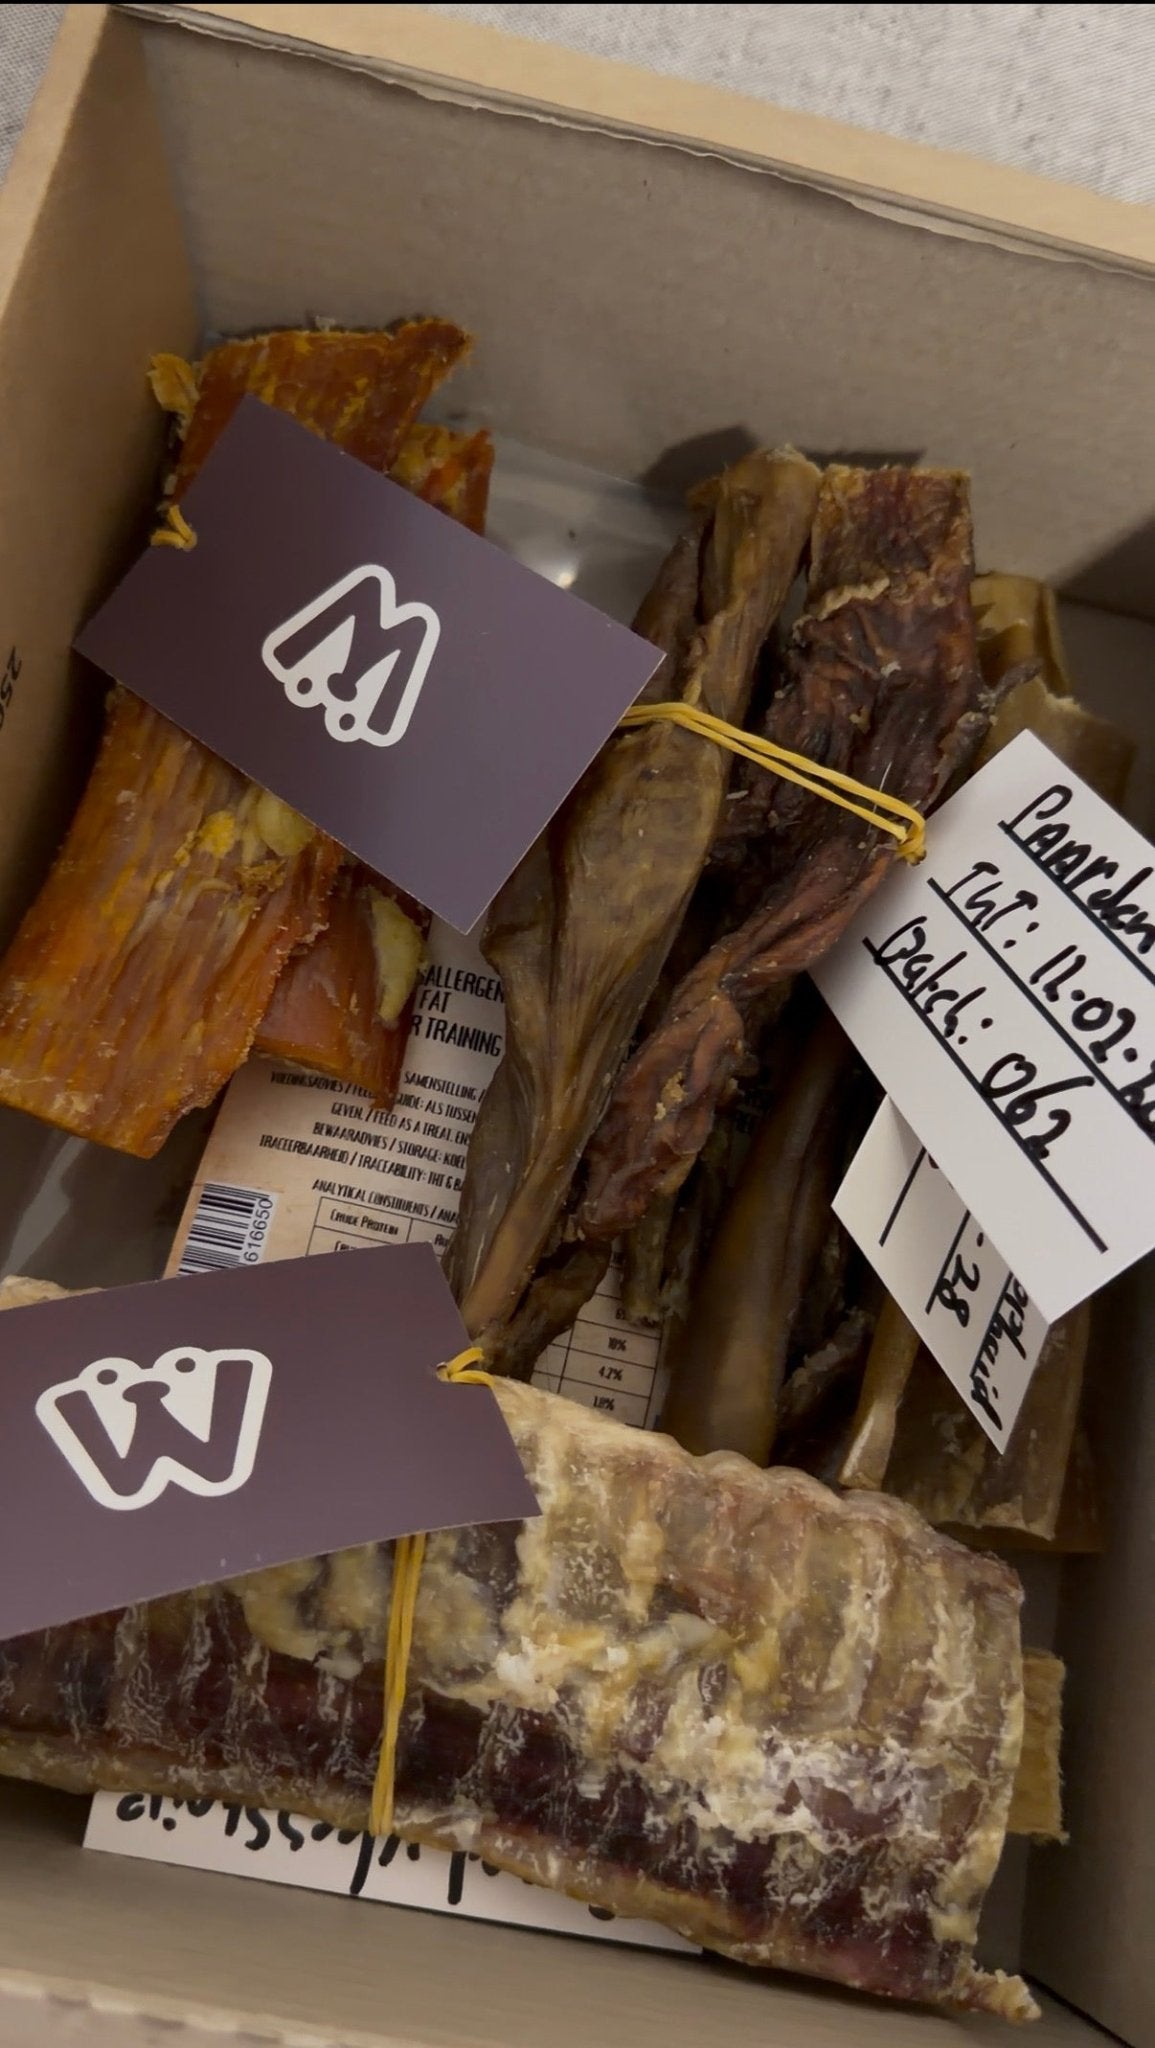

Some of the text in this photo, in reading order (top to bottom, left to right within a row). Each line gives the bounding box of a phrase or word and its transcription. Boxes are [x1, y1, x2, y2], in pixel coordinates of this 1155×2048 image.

[419, 990, 452, 1013] FAT
[425, 1016, 503, 1057] TRAINING
[404, 1070, 477, 1102] SAMENSTELLING
[980, 1052, 1095, 1160] 062
[372, 1109, 397, 1128] FEED
[398, 1117, 412, 1132] AS
[412, 1120, 421, 1133] A
[424, 1099, 445, 1116] ALS
[259, 1134, 349, 1165] TRACEERBAARHEID
[357, 1154, 426, 1182] TRACEABILITY:
[427, 1171, 445, 1188] THT
[312, 1121, 387, 1151] BEWAARADVIES
[397, 1140, 442, 1163] STORAGE:
[311, 1178, 367, 1202] ANALYTICAL
[367, 1190, 430, 1218] CONSTITUENTS
